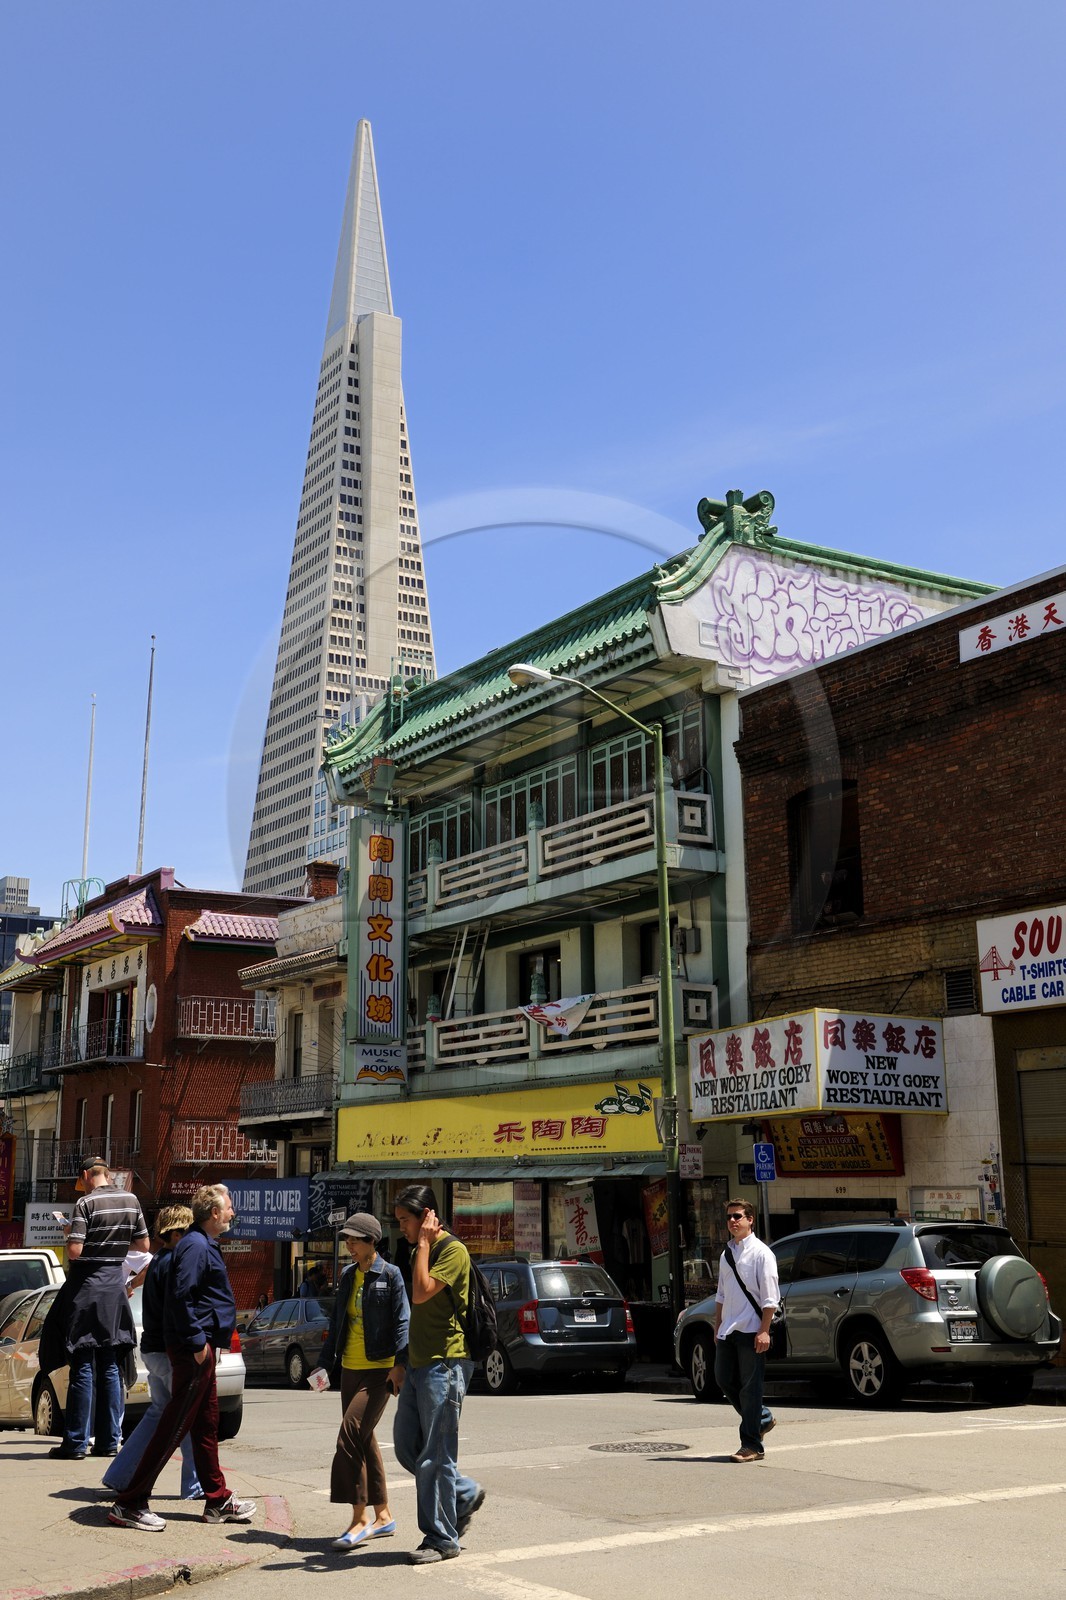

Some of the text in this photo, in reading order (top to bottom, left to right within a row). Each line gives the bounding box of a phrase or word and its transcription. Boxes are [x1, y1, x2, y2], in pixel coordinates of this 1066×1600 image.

[976, 602, 1064, 652] 香港天
[366, 834, 394, 1024] 陶陶文化城
[1012, 915, 1062, 960] SOU
[1002, 980, 1064, 1003] CABLE CAR
[699, 1020, 804, 1079] 同樂飯店
[823, 1018, 937, 1059] 同樂飯店
[361, 1048, 401, 1057] MUSIC
[865, 1055, 899, 1070] NEW
[364, 1064, 399, 1073] BOOKS
[826, 1069, 940, 1089] WOEY LOY GOEY
[694, 1063, 812, 1098] NEW WOEY LOY GOEY
[711, 1087, 798, 1115] RESTAURANT
[826, 1087, 943, 1108] RESTAURANT
[493, 1115, 609, 1144] 乐陶陶
[798, 1145, 866, 1158] RESTAURANT
[756, 1162, 774, 1171] PARKING
[760, 1171, 772, 1179] ONLY
[264, 1189, 301, 1212] FLOWER
[835, 1186, 847, 1194] 699
[263, 1216, 296, 1226] RESTAURANT
